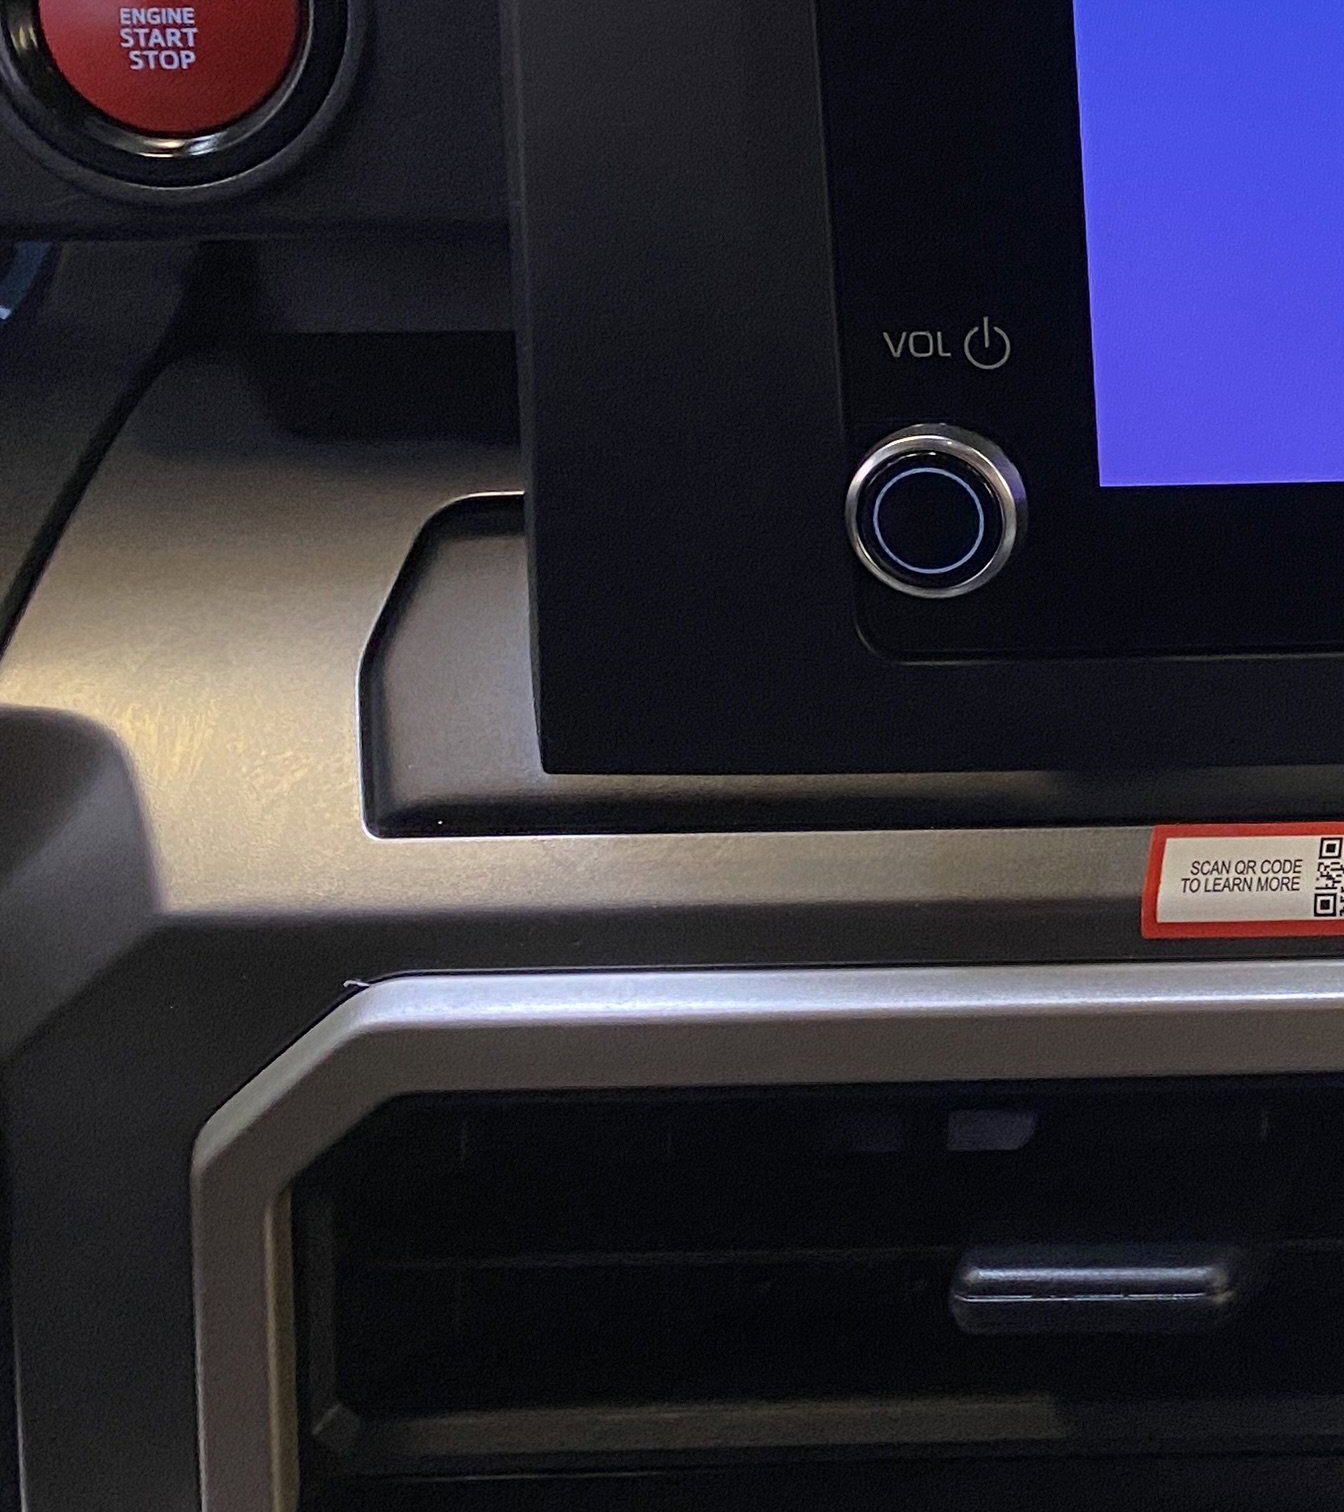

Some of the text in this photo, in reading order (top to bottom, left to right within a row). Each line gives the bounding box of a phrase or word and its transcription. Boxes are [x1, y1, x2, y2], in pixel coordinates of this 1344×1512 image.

[118, 7, 196, 26] ENGINE
[119, 27, 198, 49] START
[128, 50, 196, 70] STOP
[882, 330, 952, 358] VOL
[1190, 858, 1304, 876] SCAN QR CODE
[1181, 876, 1301, 894] TO LEARN MORE
